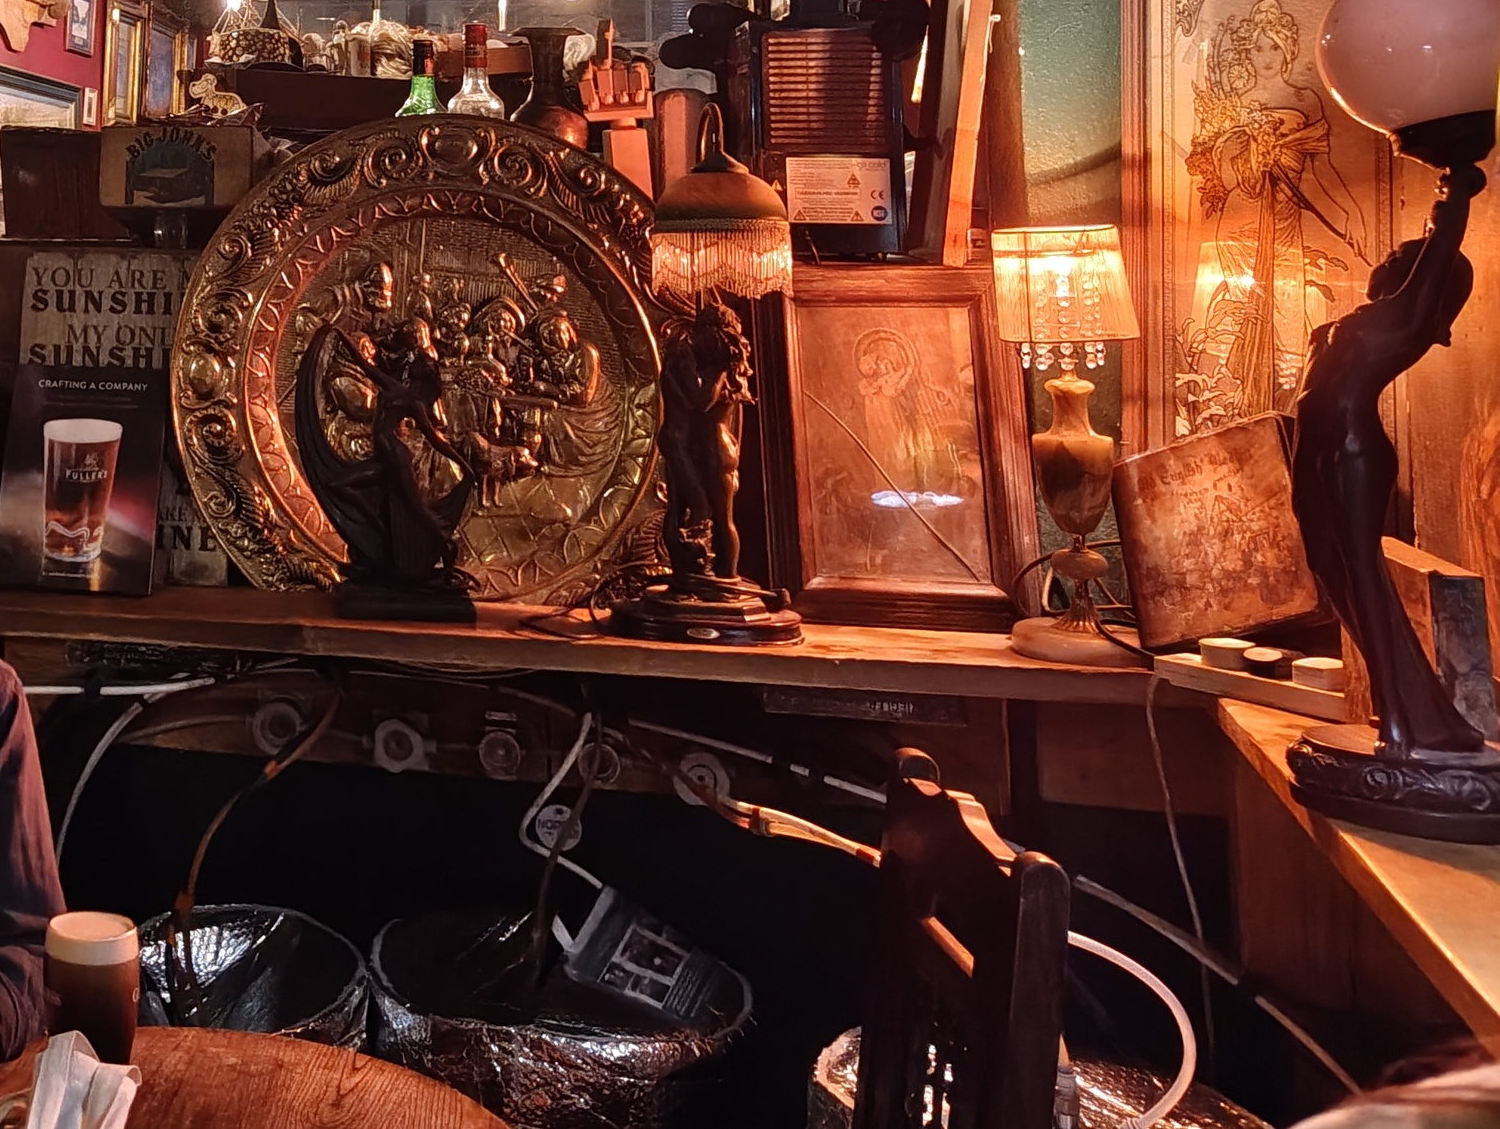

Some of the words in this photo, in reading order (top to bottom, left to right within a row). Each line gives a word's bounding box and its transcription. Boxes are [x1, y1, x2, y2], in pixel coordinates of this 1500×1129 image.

[125, 131, 154, 159] BIG
[156, 127, 217, 161] JOHN'S
[32, 266, 94, 288] YOU
[108, 268, 167, 290] ARE
[30, 288, 186, 316] SUNSHI
[65, 323, 107, 347] MY
[115, 323, 174, 348] ONL
[28, 343, 172, 369] SUNSHI
[38, 378, 88, 391] CRAFTING
[89, 380, 96, 390] A
[98, 381, 149, 392] COMPANY
[65, 469, 108, 481] FULLER'S
